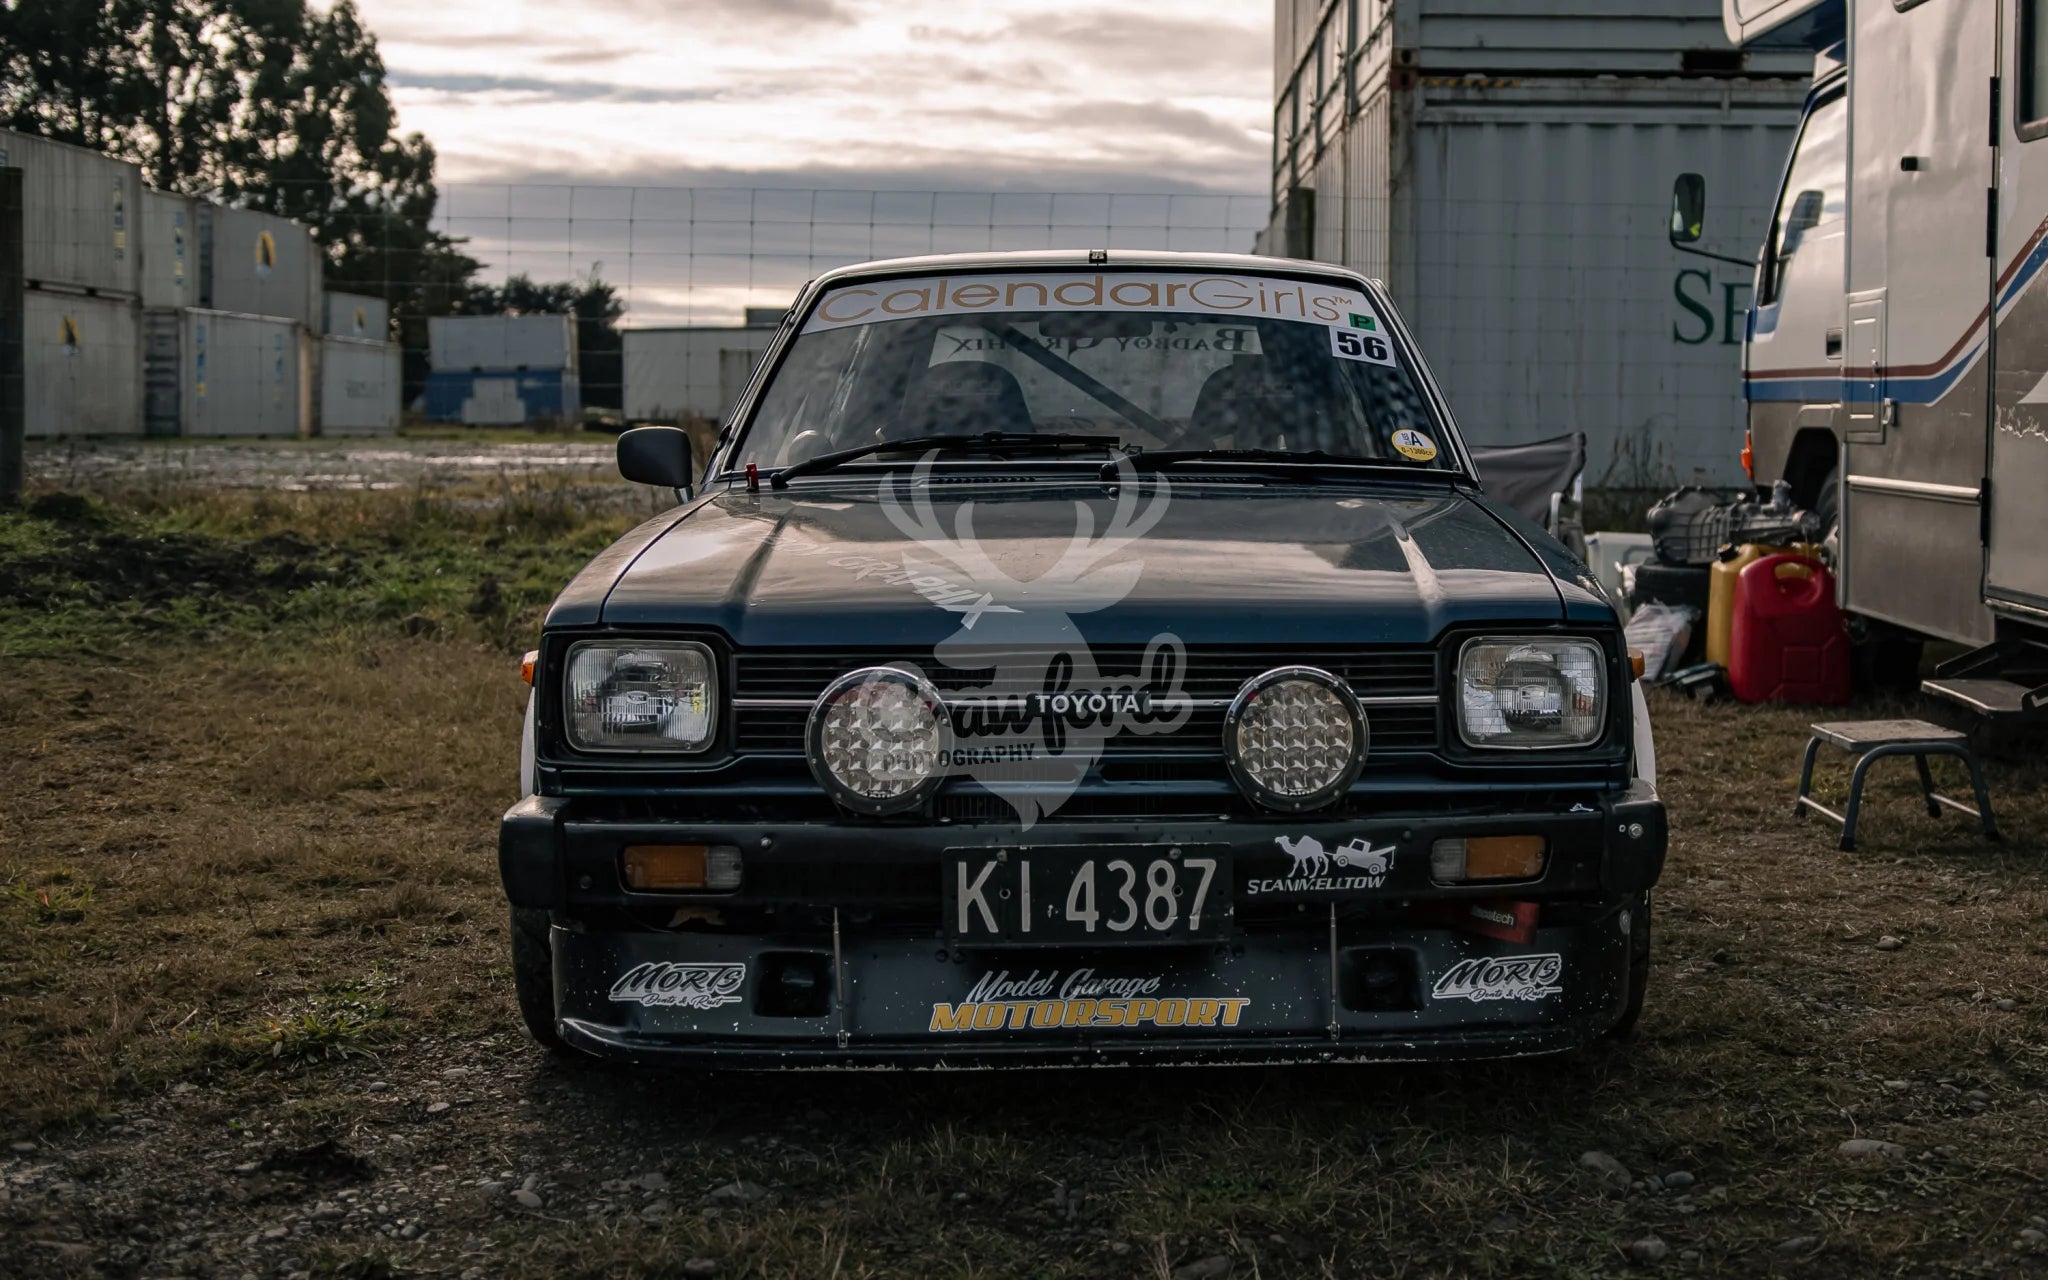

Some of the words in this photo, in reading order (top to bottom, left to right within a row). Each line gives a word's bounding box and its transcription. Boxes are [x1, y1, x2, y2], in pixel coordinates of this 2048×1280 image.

[1353, 314, 1371, 328] P
[1337, 331, 1388, 360] 56
[1411, 431, 1424, 446] A
[1034, 693, 1141, 714] TOYOTA
[1066, 859, 1218, 932] 4387
[611, 962, 745, 994] MORTS
[966, 970, 1054, 1003] Model
[1059, 968, 1160, 999] Garage
[1434, 956, 1561, 988] MORTS
[929, 998, 1250, 1032] MOTORSPORT
